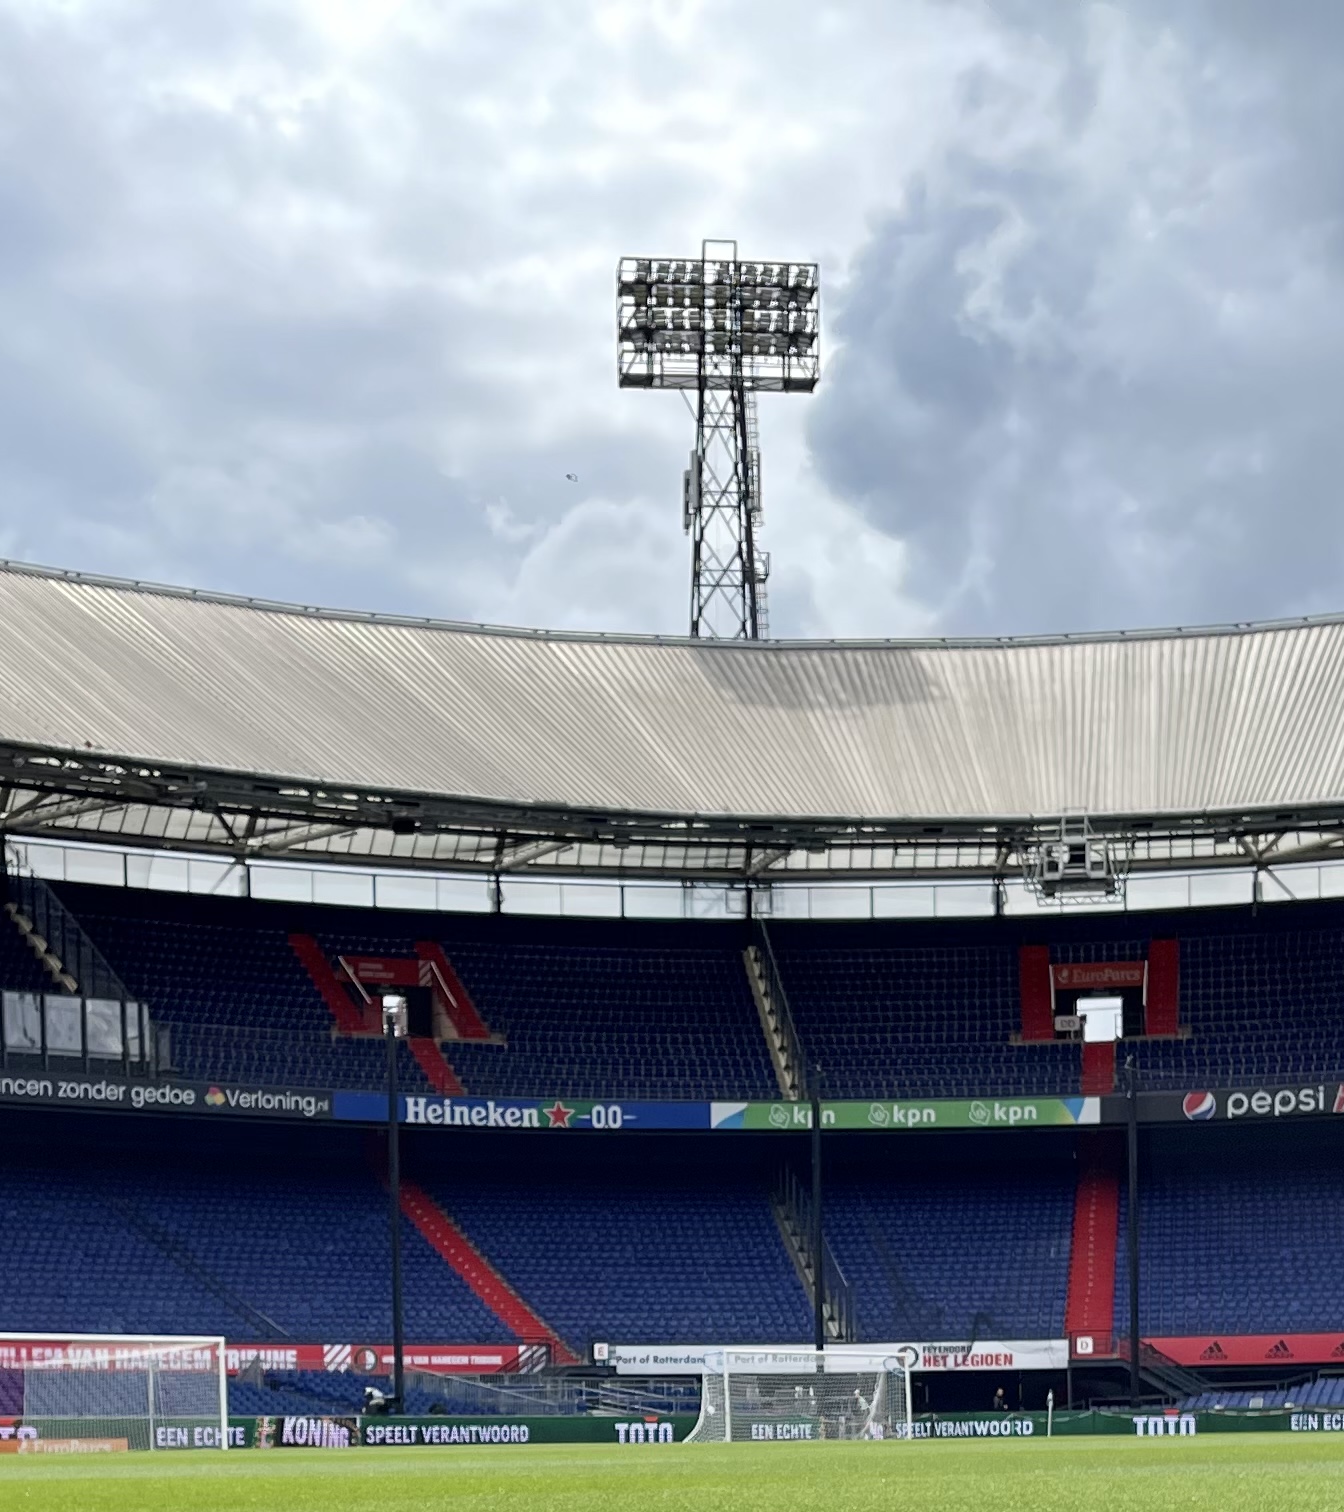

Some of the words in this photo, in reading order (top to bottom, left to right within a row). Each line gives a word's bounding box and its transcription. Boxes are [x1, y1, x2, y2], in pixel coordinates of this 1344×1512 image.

[1072, 967, 1140, 985] EuroParcs
[58, 1080, 126, 1101] zonder
[131, 1086, 196, 1108] gedoe
[225, 1089, 329, 1117] Verloning.nl
[1227, 1086, 1325, 1119] pepsi
[404, 1097, 540, 1128] Heineken
[893, 1103, 936, 1127] kpn
[994, 1102, 1037, 1125] kpn
[616, 1355, 637, 1364] Port
[639, 1354, 650, 1364] of
[653, 1355, 706, 1365] Rotterdam
[735, 1354, 755, 1364] Port
[758, 1353, 769, 1364] of
[772, 1353, 826, 1364] Rotterda
[923, 1345, 972, 1354] FEYENOORD
[923, 1354, 949, 1367] HET
[953, 1353, 1013, 1367] LEGIOEN
[156, 1427, 188, 1447] EEN
[194, 1426, 246, 1447] ECHTE
[281, 1416, 350, 1448] KONING
[366, 1425, 418, 1444] SPEELT
[422, 1424, 529, 1444] VERANTWOORD
[615, 1421, 674, 1444] TOTO
[751, 1423, 774, 1440] EEN
[776, 1422, 812, 1440] ECHTE
[934, 1420, 1034, 1437] VERANTWOORD
[1132, 1415, 1196, 1436] TOTO
